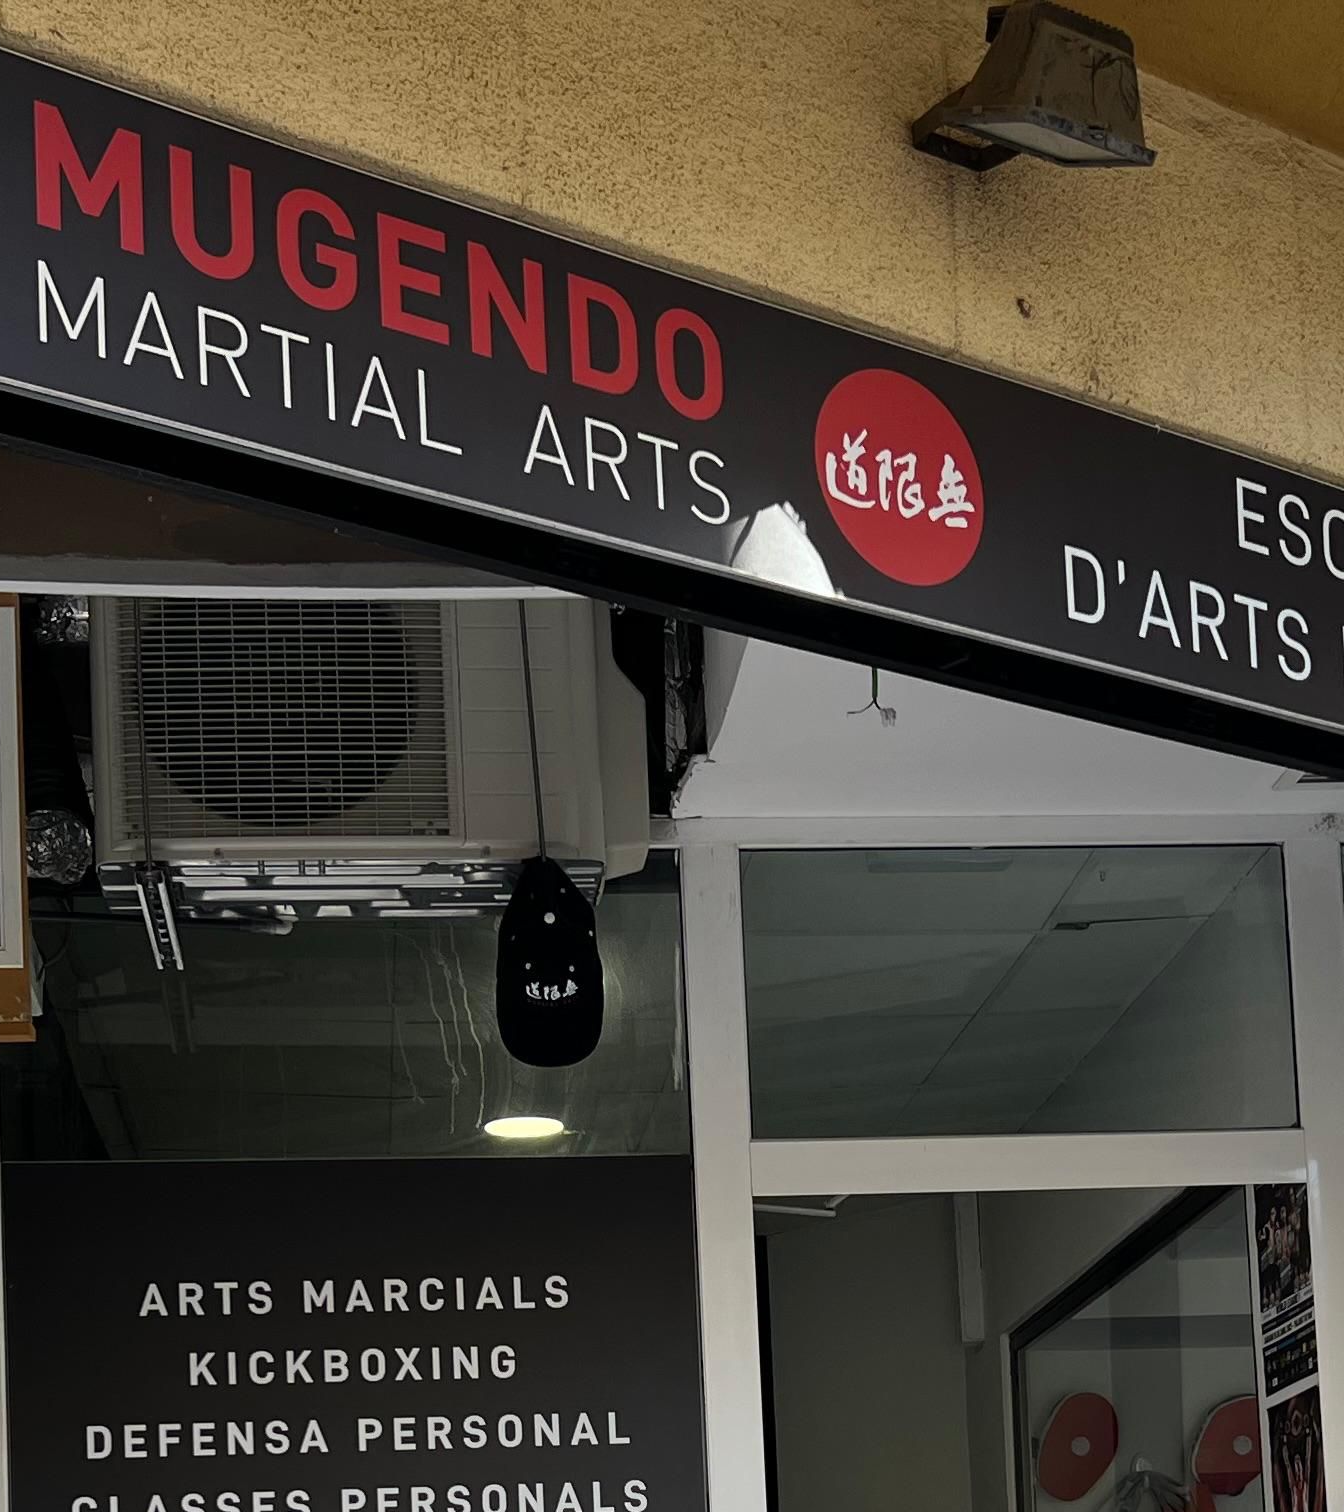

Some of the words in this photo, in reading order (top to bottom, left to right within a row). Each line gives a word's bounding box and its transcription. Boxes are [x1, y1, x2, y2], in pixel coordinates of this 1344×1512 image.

[33, 99, 722, 421] MUGENDO
[36, 260, 463, 456] MARTIAL
[523, 404, 732, 524] ARTS
[1064, 545, 1311, 681] D'ARTS
[139, 1281, 273, 1317] ARTS
[303, 1275, 570, 1313] MARCIALS
[188, 1345, 518, 1386] KICKBOXING
[85, 1419, 330, 1459] DEFENSA
[357, 1411, 631, 1452] PERSONAL
